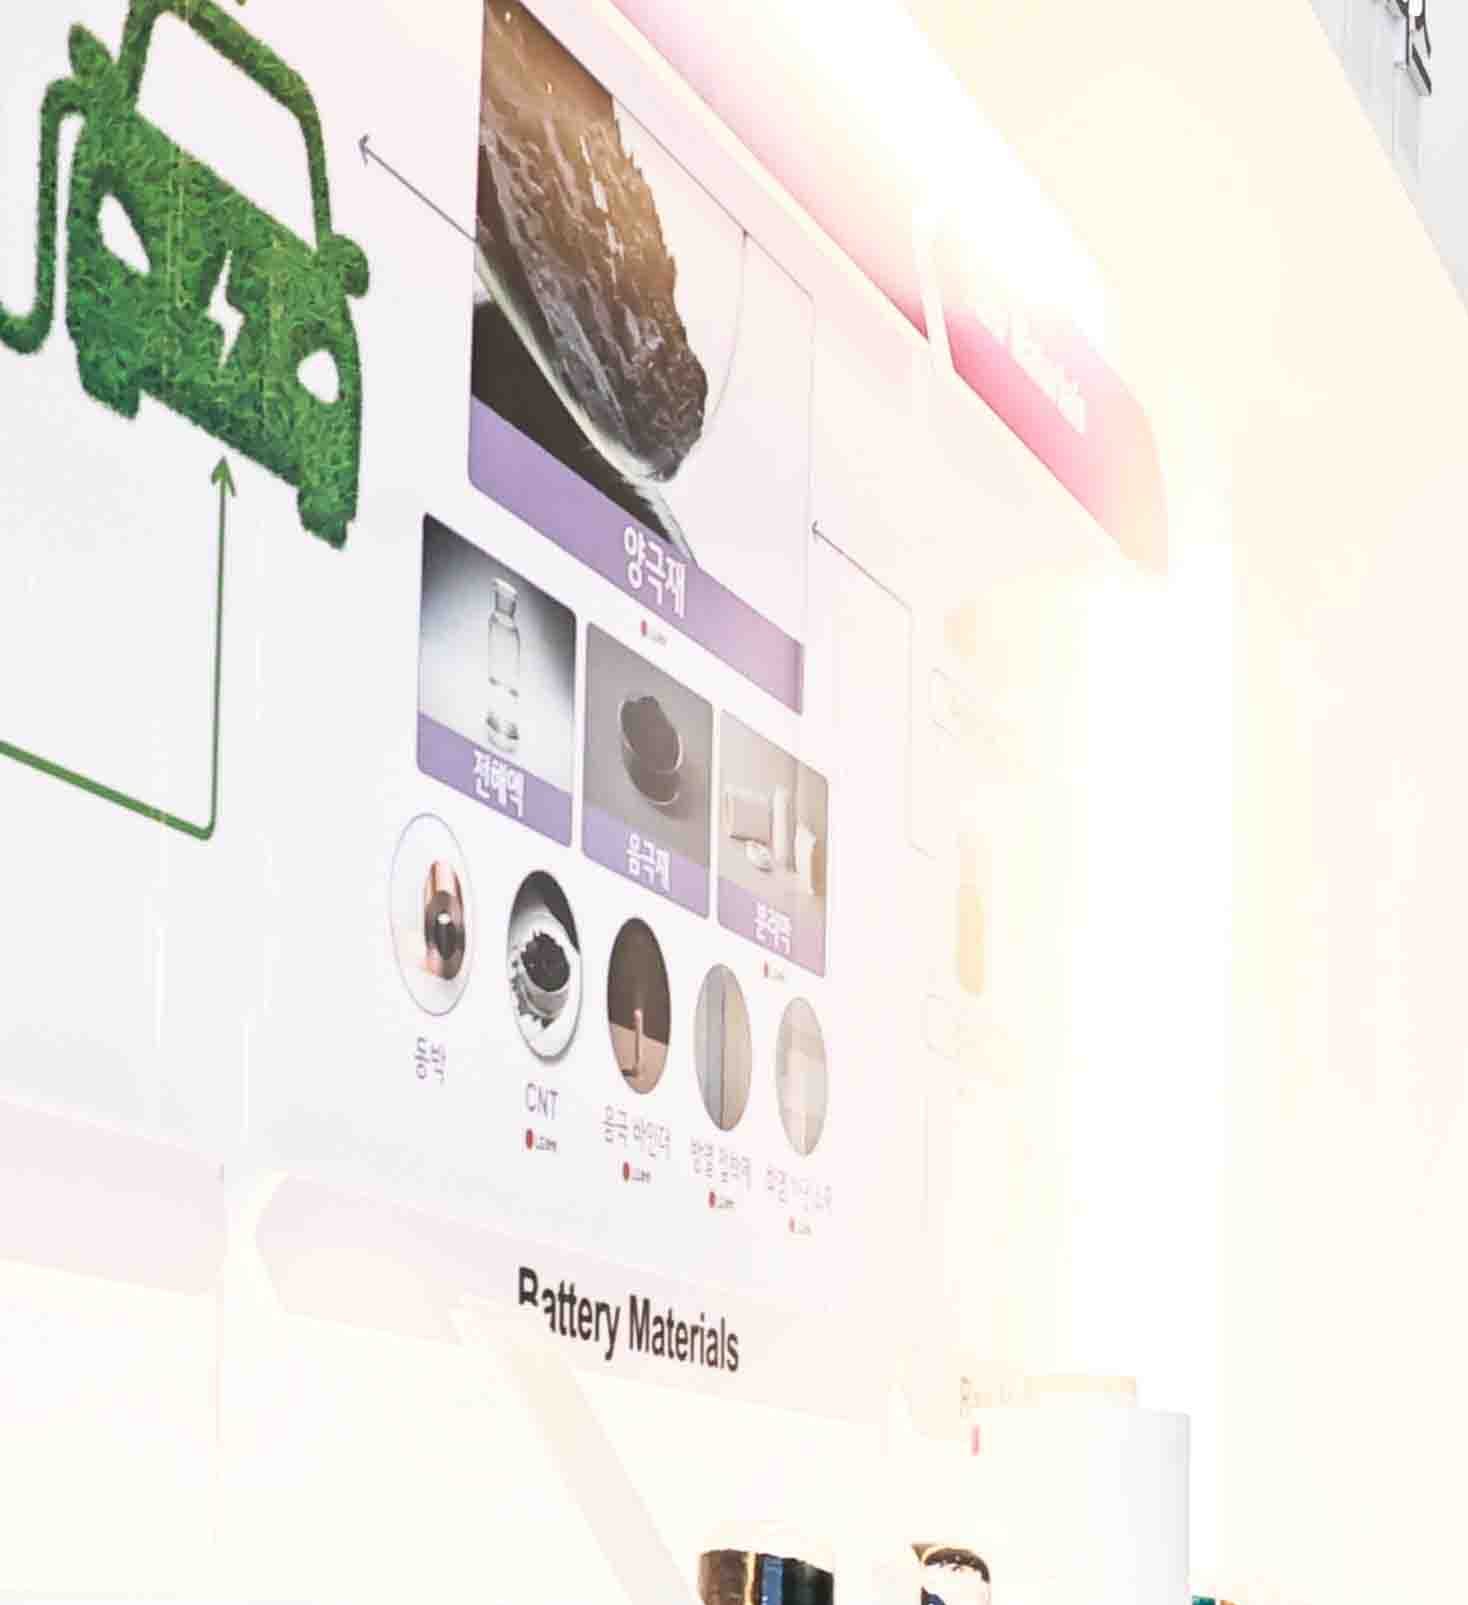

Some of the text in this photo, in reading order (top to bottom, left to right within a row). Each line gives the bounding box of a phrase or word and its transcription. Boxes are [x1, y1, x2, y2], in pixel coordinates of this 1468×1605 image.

[624, 526, 686, 619] 양극재
[473, 748, 525, 818] 전해액
[626, 830, 671, 894] 음극재
[526, 1082, 560, 1121] CNT
[518, 1266, 739, 1373] Battery Materials
